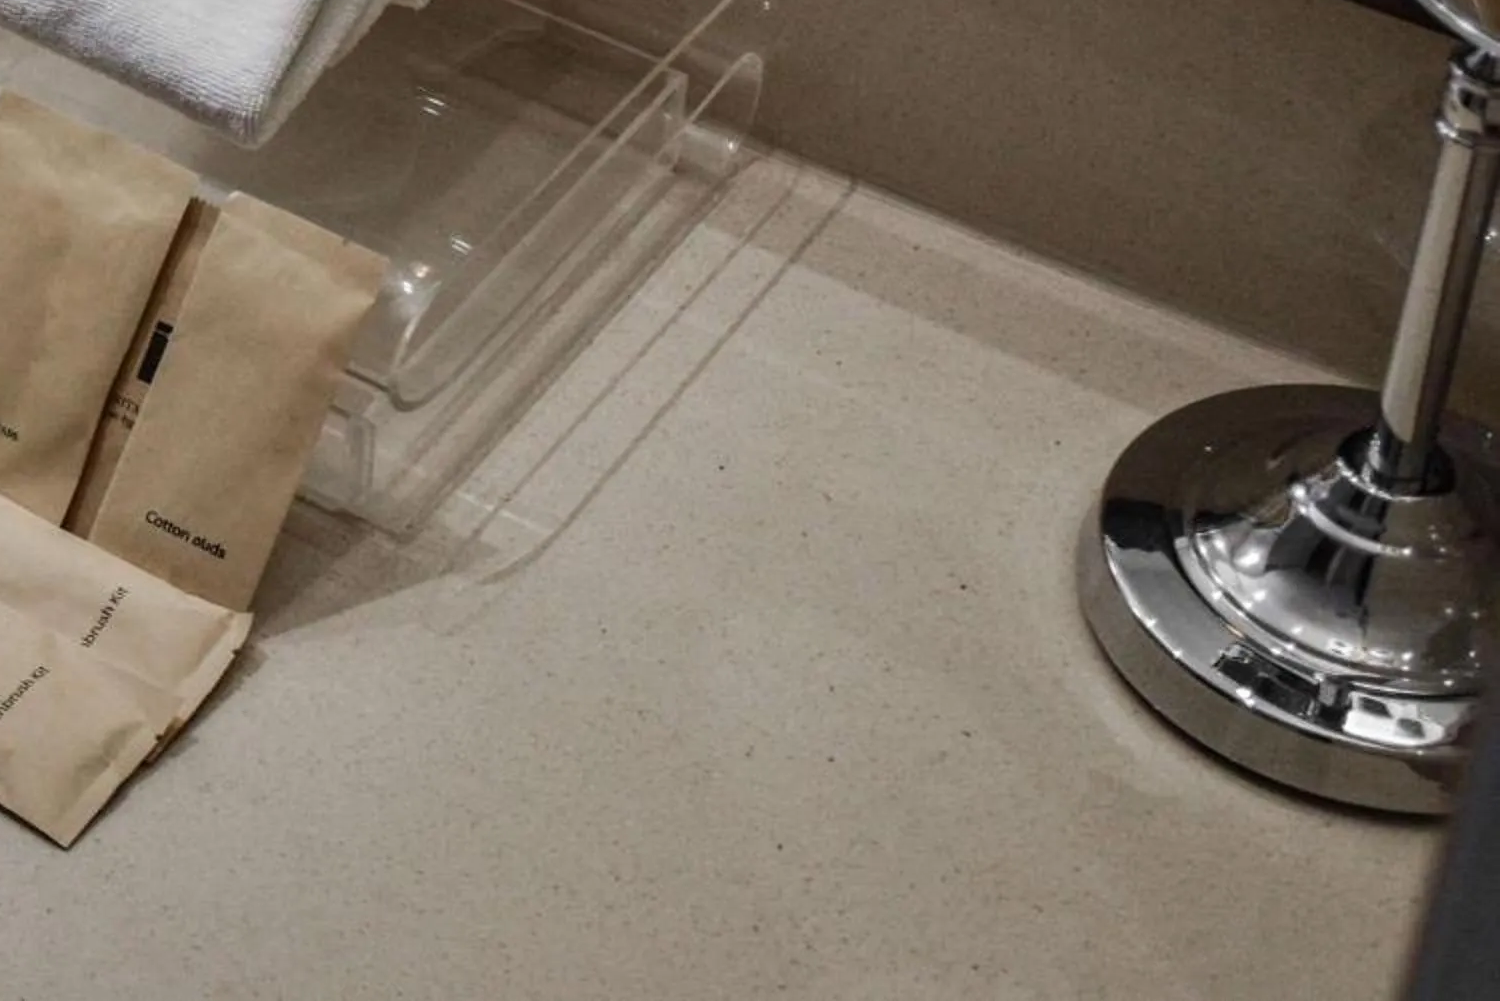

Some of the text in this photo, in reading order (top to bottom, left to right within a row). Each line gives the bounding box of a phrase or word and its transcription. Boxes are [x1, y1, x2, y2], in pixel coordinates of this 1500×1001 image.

[146, 510, 190, 542] Cotton
[109, 587, 129, 605] Kit
[31, 665, 51, 680] Kit
